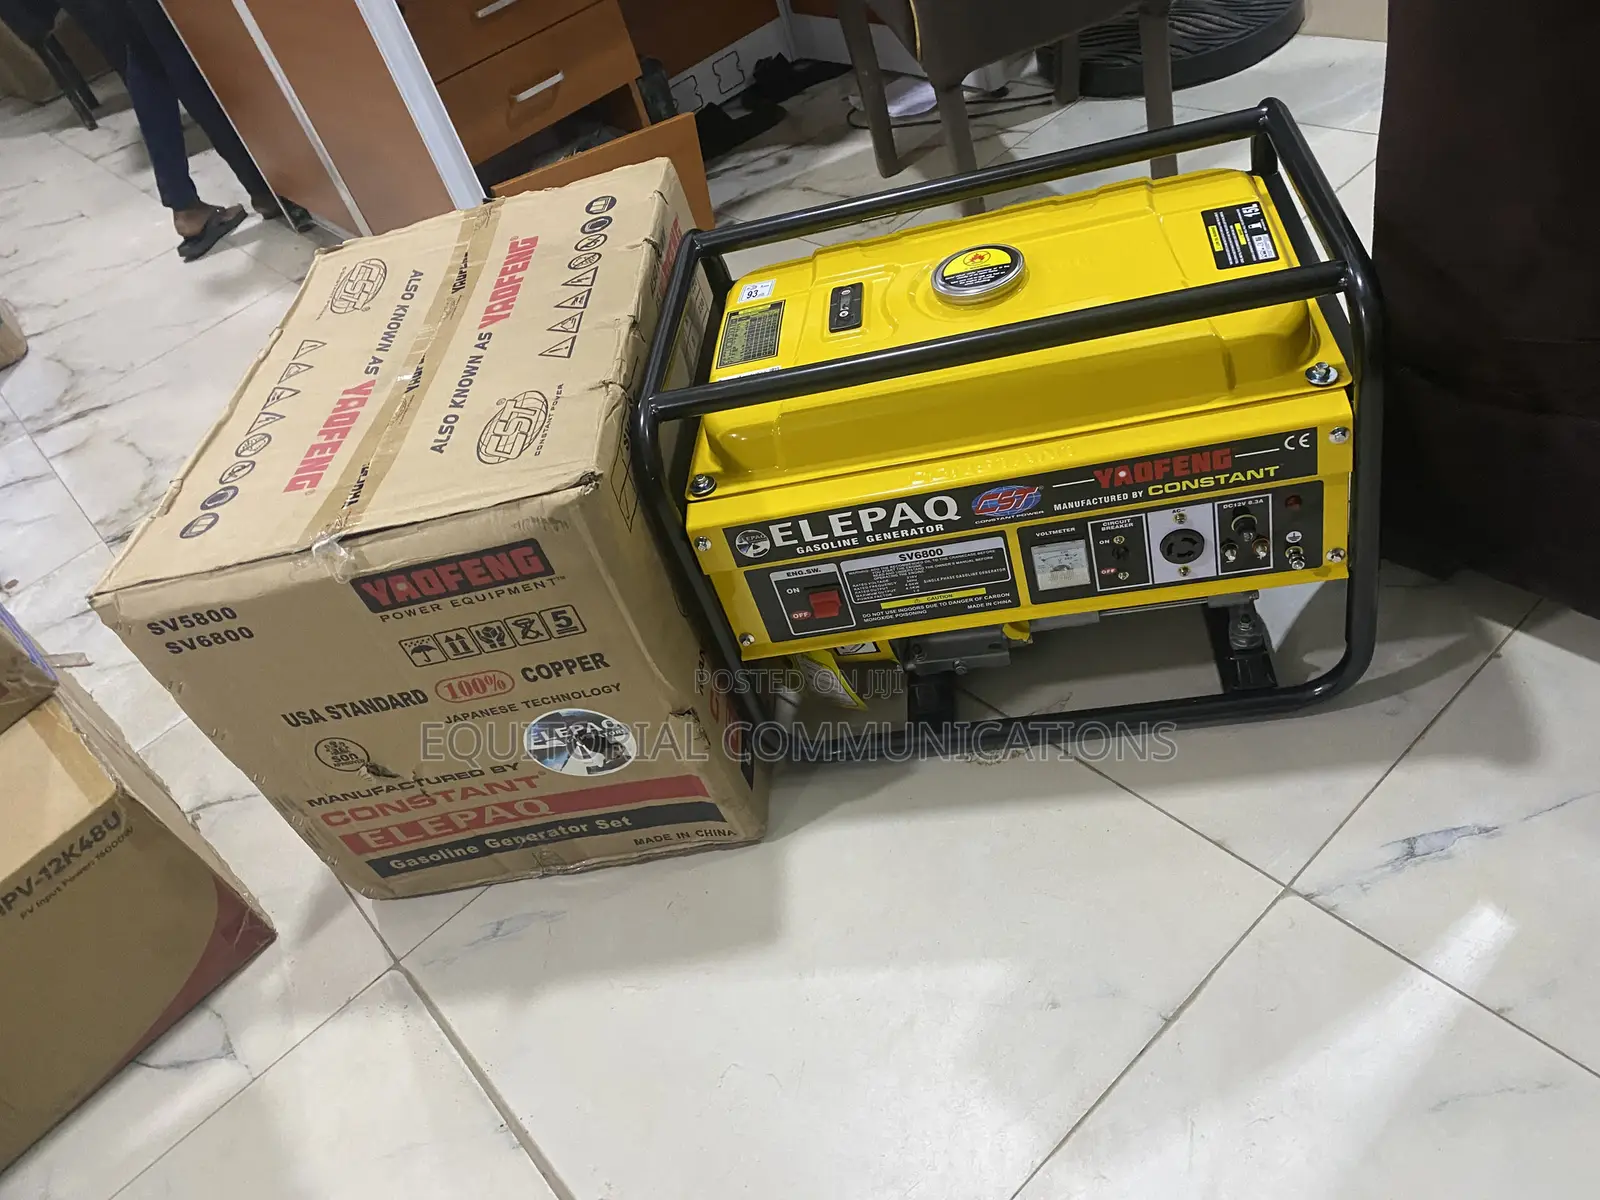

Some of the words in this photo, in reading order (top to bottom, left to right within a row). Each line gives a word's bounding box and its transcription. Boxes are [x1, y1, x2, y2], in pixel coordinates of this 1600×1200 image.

[401, 269, 424, 301] ALSO
[478, 235, 539, 330] YAOFENG
[747, 289, 759, 299] 93
[376, 304, 409, 352] KNOWN
[473, 331, 493, 350] AS
[364, 355, 384, 376] AS
[448, 355, 484, 409] KNOWN
[283, 379, 377, 493] YAOFENG
[430, 413, 460, 454] ALSO
[534, 412, 554, 457] CONSTANT
[1284, 432, 1310, 450] CE
[1093, 447, 1233, 489] YAOFENG
[975, 486, 1038, 516] CST
[1053, 493, 1129, 511] MANUFACTURED
[1131, 490, 1144, 499] BY
[1148, 465, 1280, 496] CONSTANT
[975, 515, 1016, 525] CONSTANT
[1016, 510, 1045, 519] POWER
[1222, 501, 1246, 510] DC12V
[769, 495, 962, 548] ELEPAQ
[1035, 527, 1076, 537] VOLTMETER
[1101, 522, 1134, 531] BREAKER
[1102, 518, 1131, 527] CIRCUIT
[796, 537, 860, 555] GASOLINE
[866, 523, 945, 543] GENERATOR
[898, 548, 944, 562] SV6800
[361, 546, 545, 607] YAOFENG
[786, 567, 822, 577] ENG.SW.
[786, 587, 800, 595] ON
[897, 604, 925, 614] INDOORS
[948, 598, 974, 606] DANGER
[984, 592, 1010, 600] CARBON
[926, 593, 954, 602] CAUTION
[993, 599, 1012, 607] CHINA
[146, 606, 238, 637] SV5800
[379, 603, 443, 623] POWER
[792, 611, 808, 619] OFF
[863, 614, 894, 623] MONOXIDE
[895, 609, 928, 618] POISONING
[165, 626, 255, 655] SV6800
[281, 707, 328, 728] USA
[325, 688, 429, 722] STANDARD
[444, 673, 507, 700] 100%
[520, 652, 612, 683] COPPER
[445, 703, 520, 725] JAPANESE
[521, 682, 622, 710] TECHNOLOGY
[530, 718, 617, 751] ELEPAQ
[306, 769, 485, 808] MANUFACTURED
[490, 762, 520, 774] BY
[321, 774, 541, 828] CONSTANT
[358, 798, 556, 850] ELEPAQ
[633, 833, 673, 846] MADE
[675, 831, 691, 840] IN
[695, 828, 737, 838] CHINA
[389, 843, 480, 871] Gasoline
[484, 822, 589, 850] Generator
[596, 816, 633, 830] Set
[20, 905, 34, 921] PV
[36, 886, 62, 908] Input
